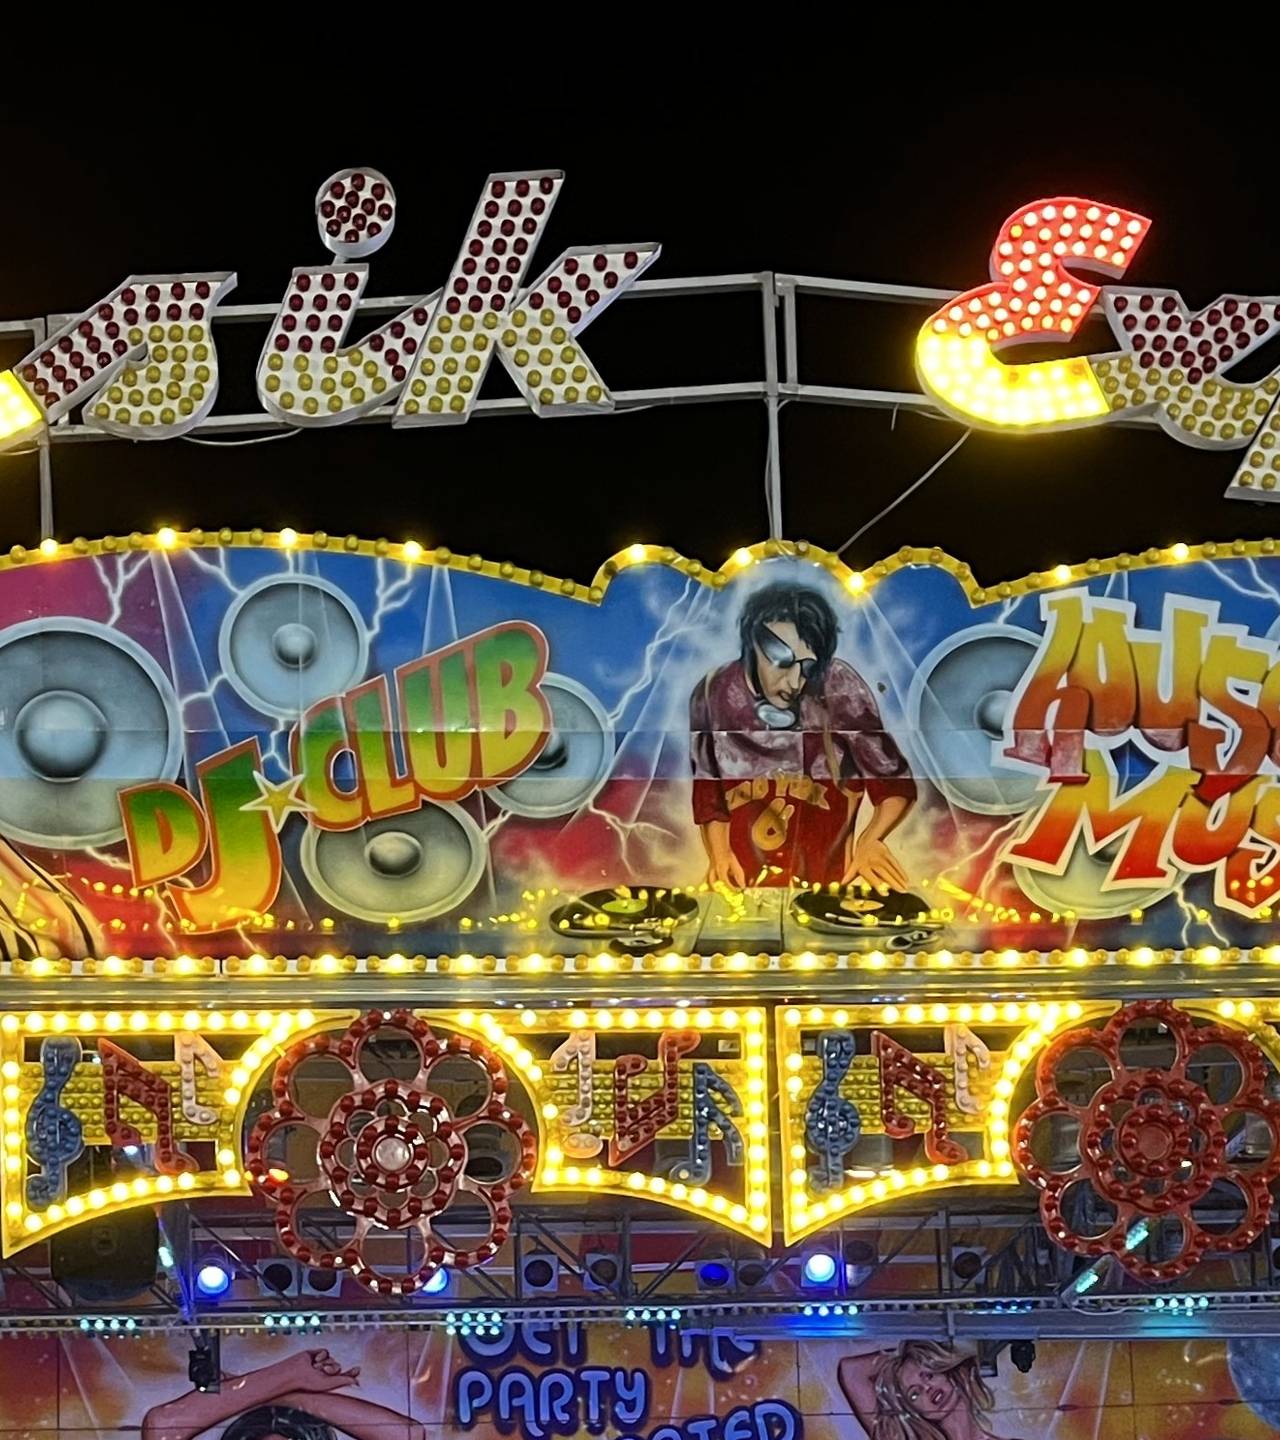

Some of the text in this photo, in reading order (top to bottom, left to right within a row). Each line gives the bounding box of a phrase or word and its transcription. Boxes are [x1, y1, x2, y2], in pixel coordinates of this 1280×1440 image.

[118, 619, 552, 933] DJ CLUB
[457, 1368, 648, 1438] PARTY
